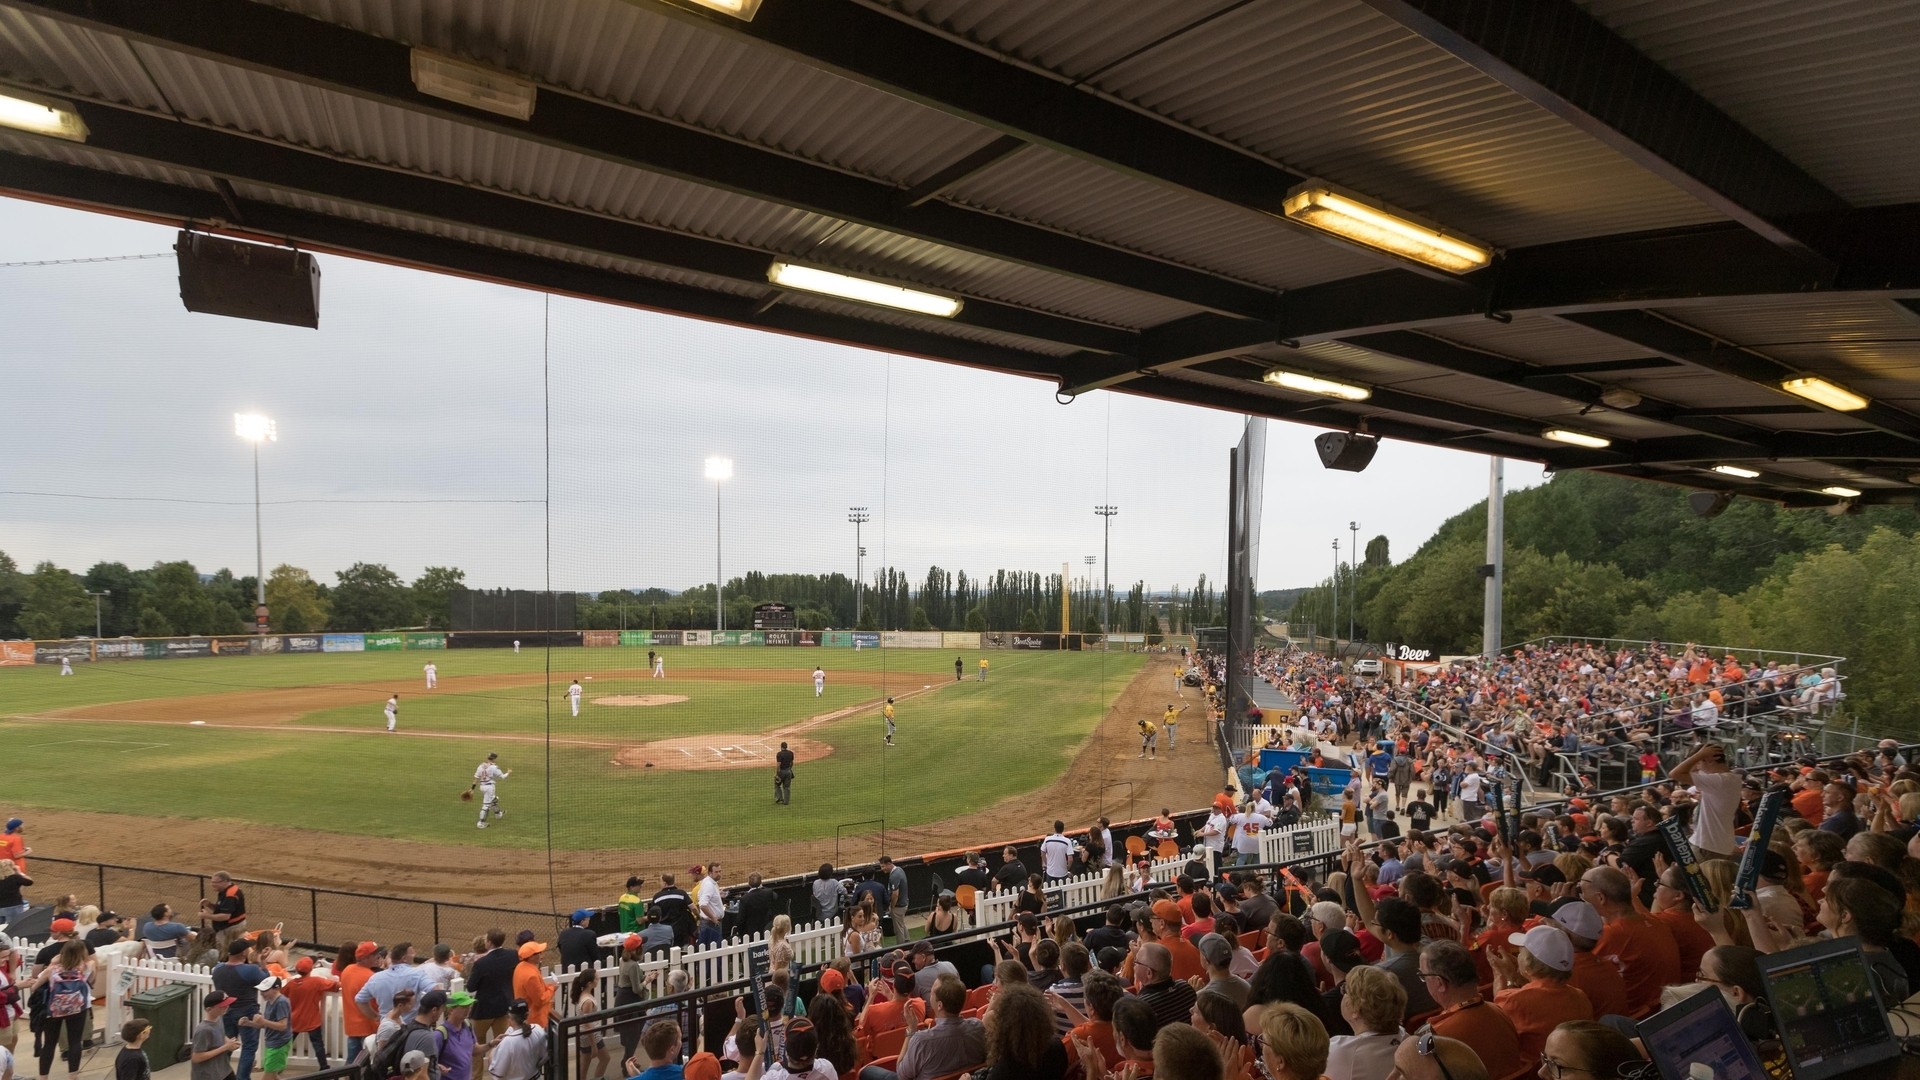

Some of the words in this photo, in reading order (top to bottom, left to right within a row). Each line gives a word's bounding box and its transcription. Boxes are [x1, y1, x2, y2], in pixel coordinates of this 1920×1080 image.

[1398, 645, 1431, 661] Beer
[1243, 822, 1259, 833] 45
[1665, 822, 1694, 865] barlens
[752, 948, 769, 959] barl
[755, 975, 768, 1011] barlens
